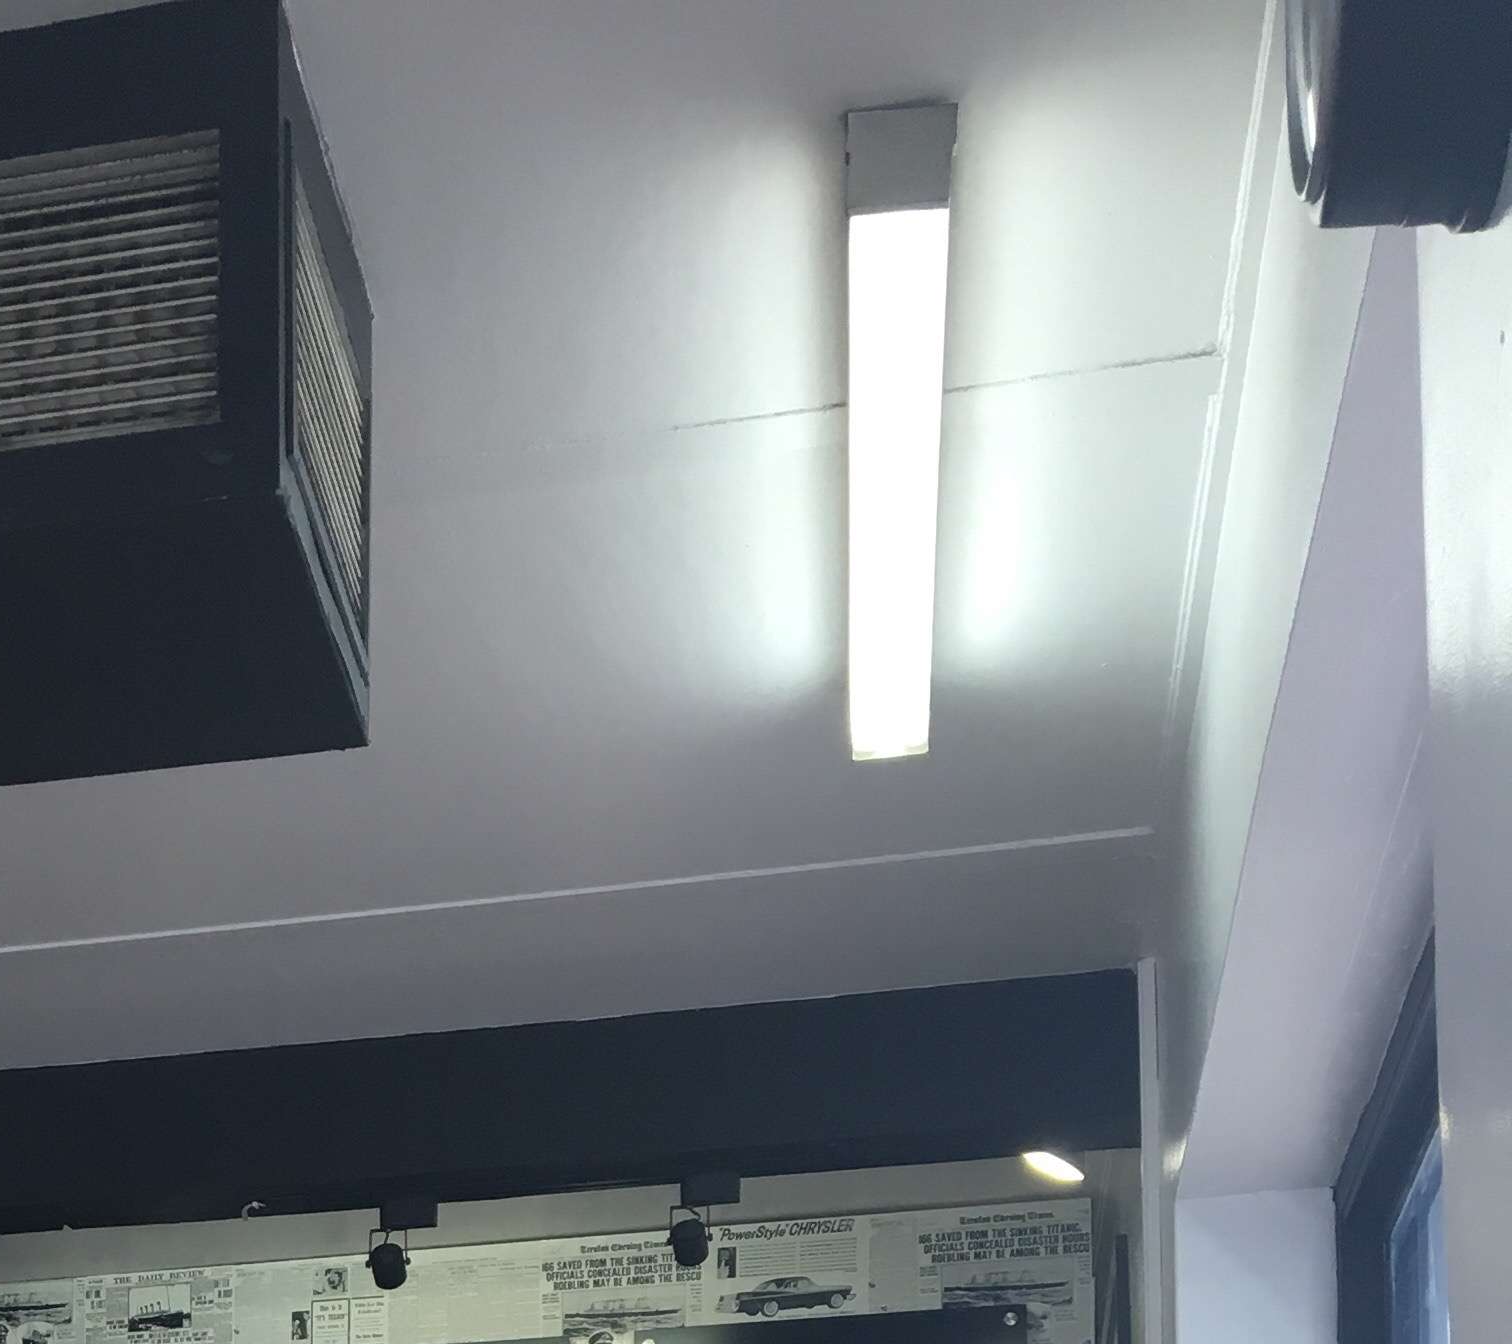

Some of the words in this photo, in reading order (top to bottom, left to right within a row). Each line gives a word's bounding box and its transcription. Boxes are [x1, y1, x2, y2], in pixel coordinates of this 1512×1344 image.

[789, 1218, 855, 1236] CHRYSLER
[557, 1260, 582, 1270] SAVED
[593, 1278, 610, 1288] MAY
